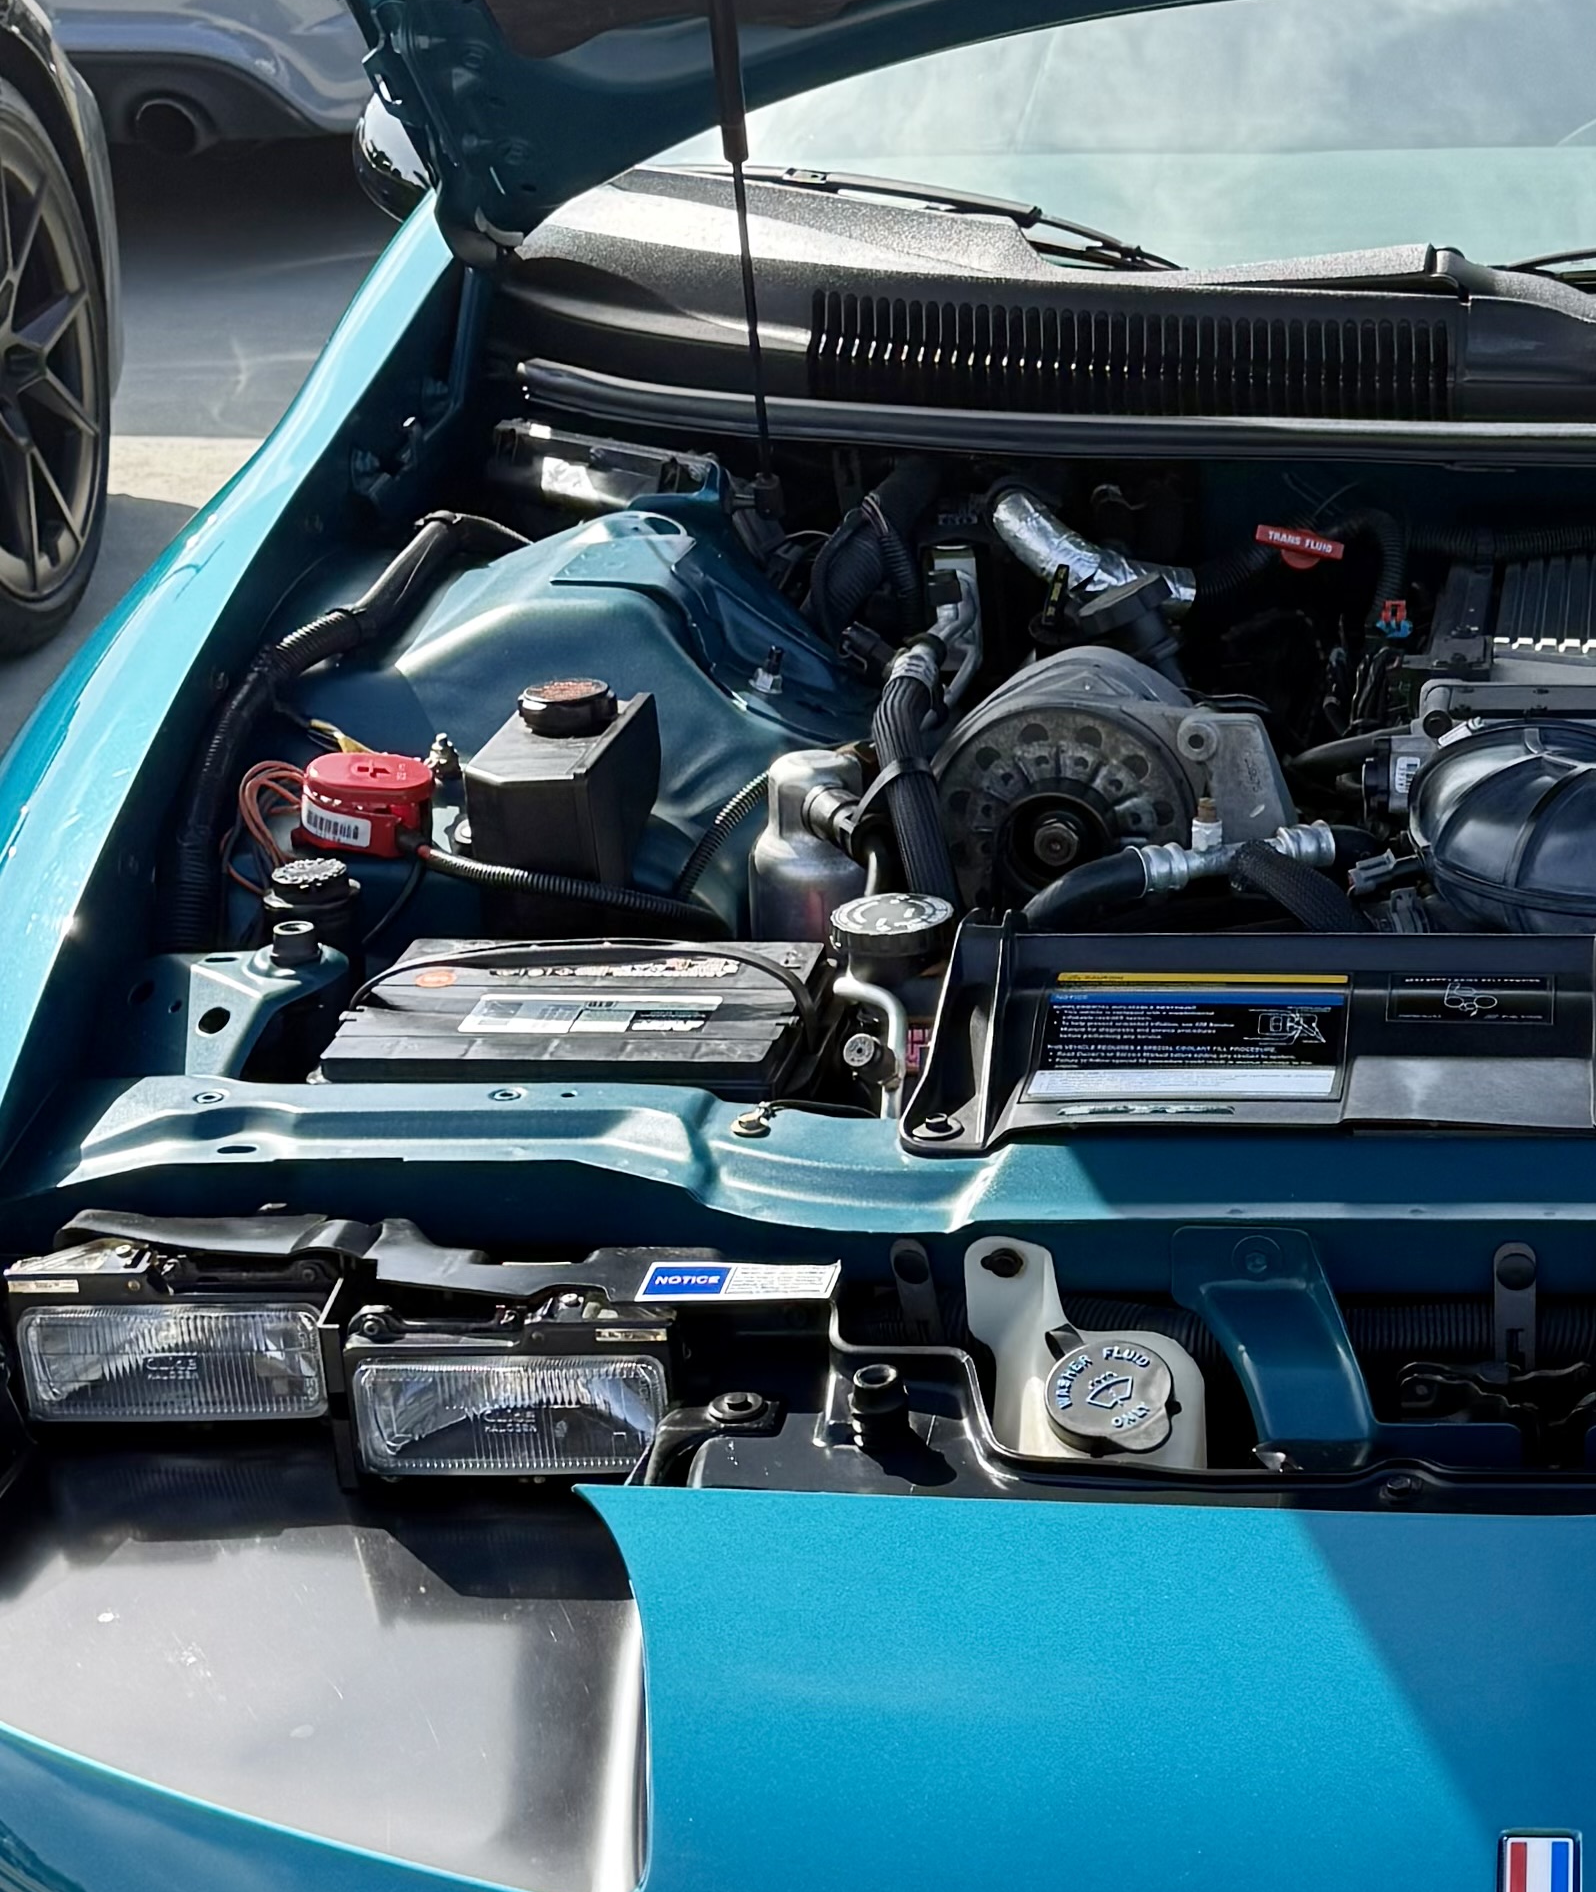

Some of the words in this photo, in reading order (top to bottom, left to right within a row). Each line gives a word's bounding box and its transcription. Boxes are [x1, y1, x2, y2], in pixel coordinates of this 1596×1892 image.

[1267, 530, 1301, 546] TRANS
[1304, 538, 1333, 554] FLUID
[654, 1275, 721, 1285] NOTICE
[1055, 1354, 1093, 1410] WASHER
[1102, 1346, 1151, 1368] FLUID
[1111, 1402, 1151, 1428] ONLY
